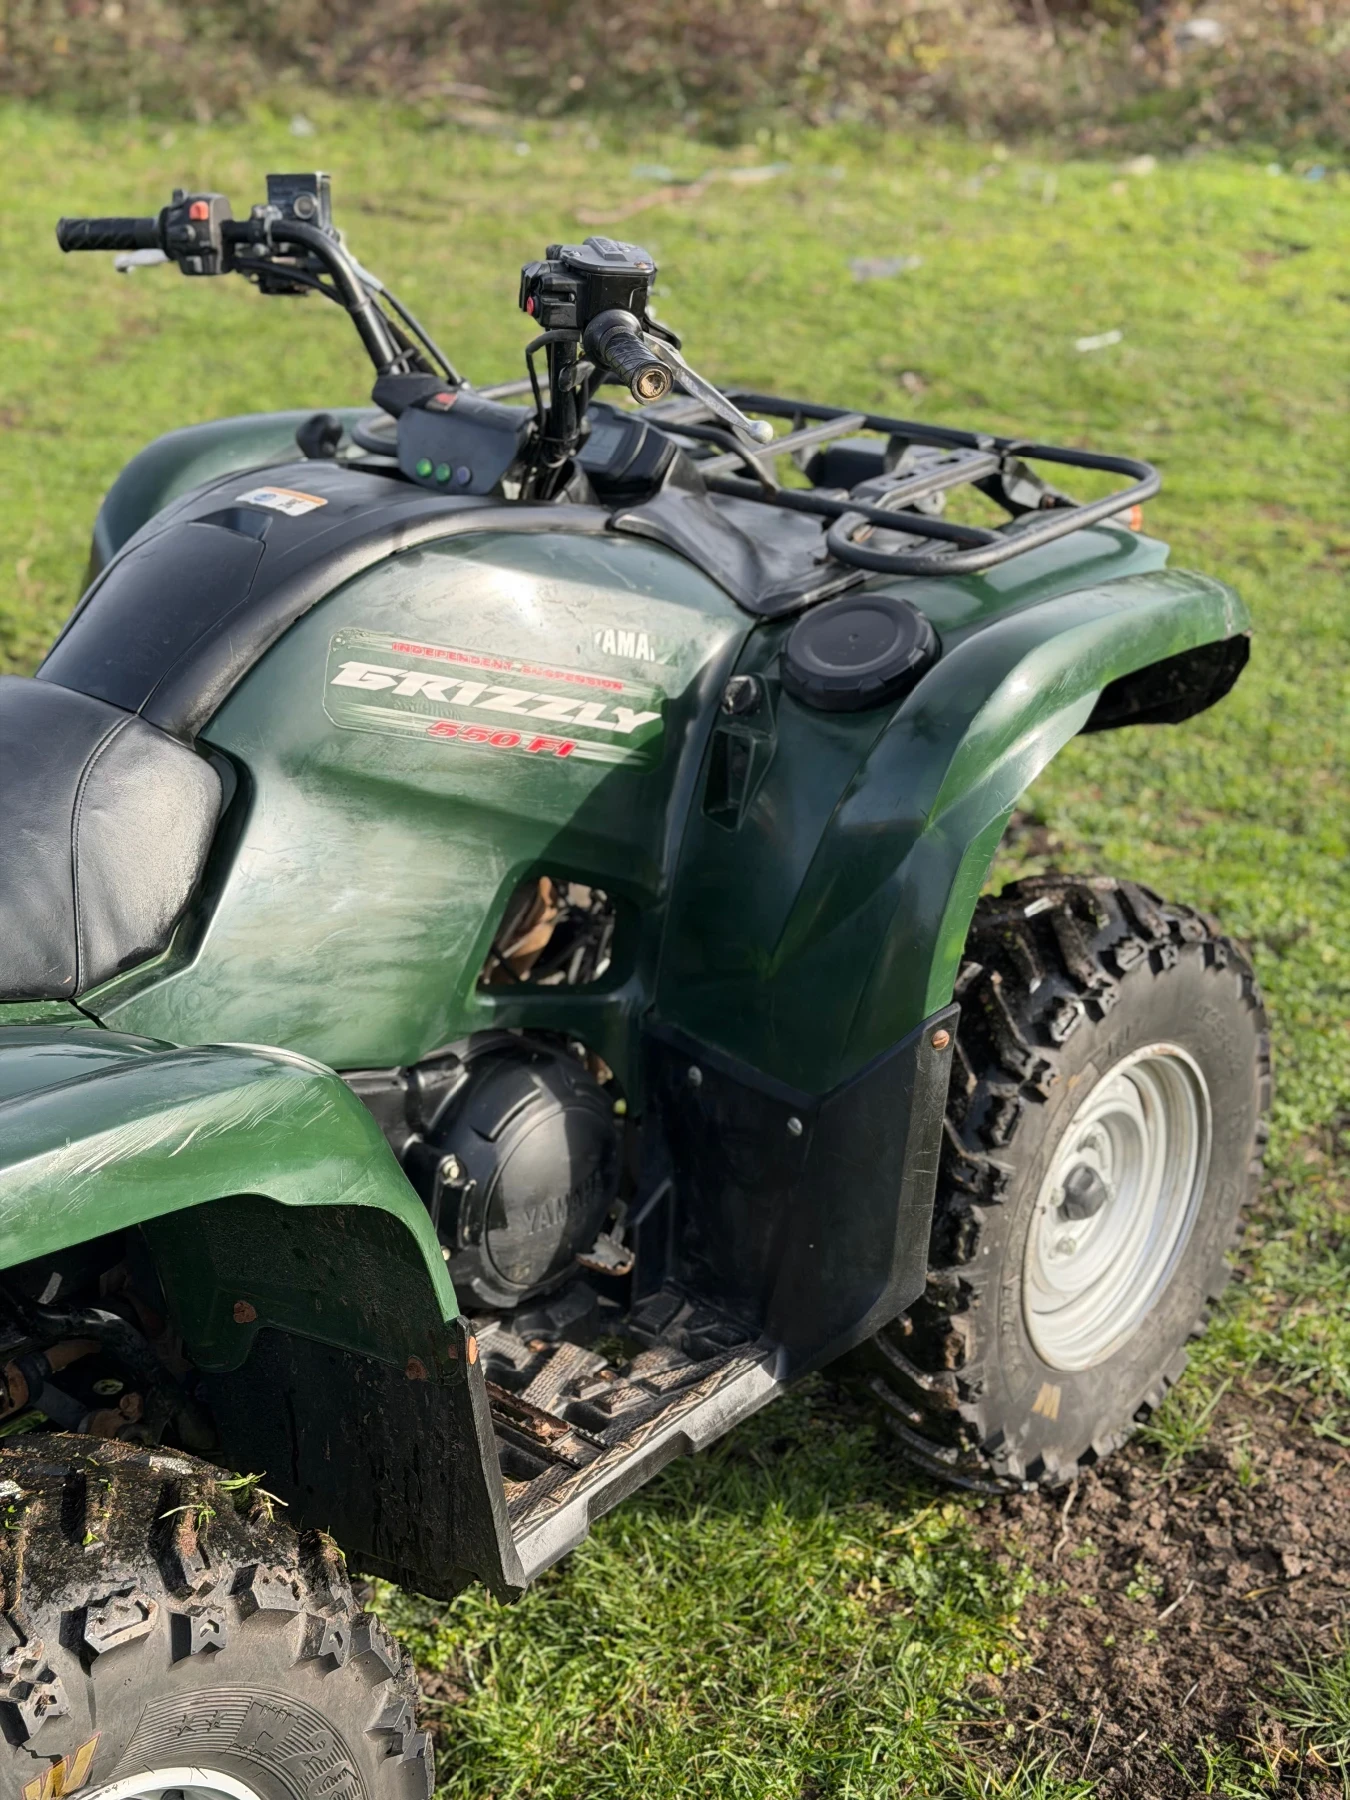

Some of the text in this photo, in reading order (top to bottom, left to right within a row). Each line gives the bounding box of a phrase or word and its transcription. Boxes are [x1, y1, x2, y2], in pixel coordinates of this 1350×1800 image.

[391, 641, 514, 671] INDEPENDENT
[330, 661, 662, 734] GRIZZLY
[426, 719, 578, 758] 550 FI
